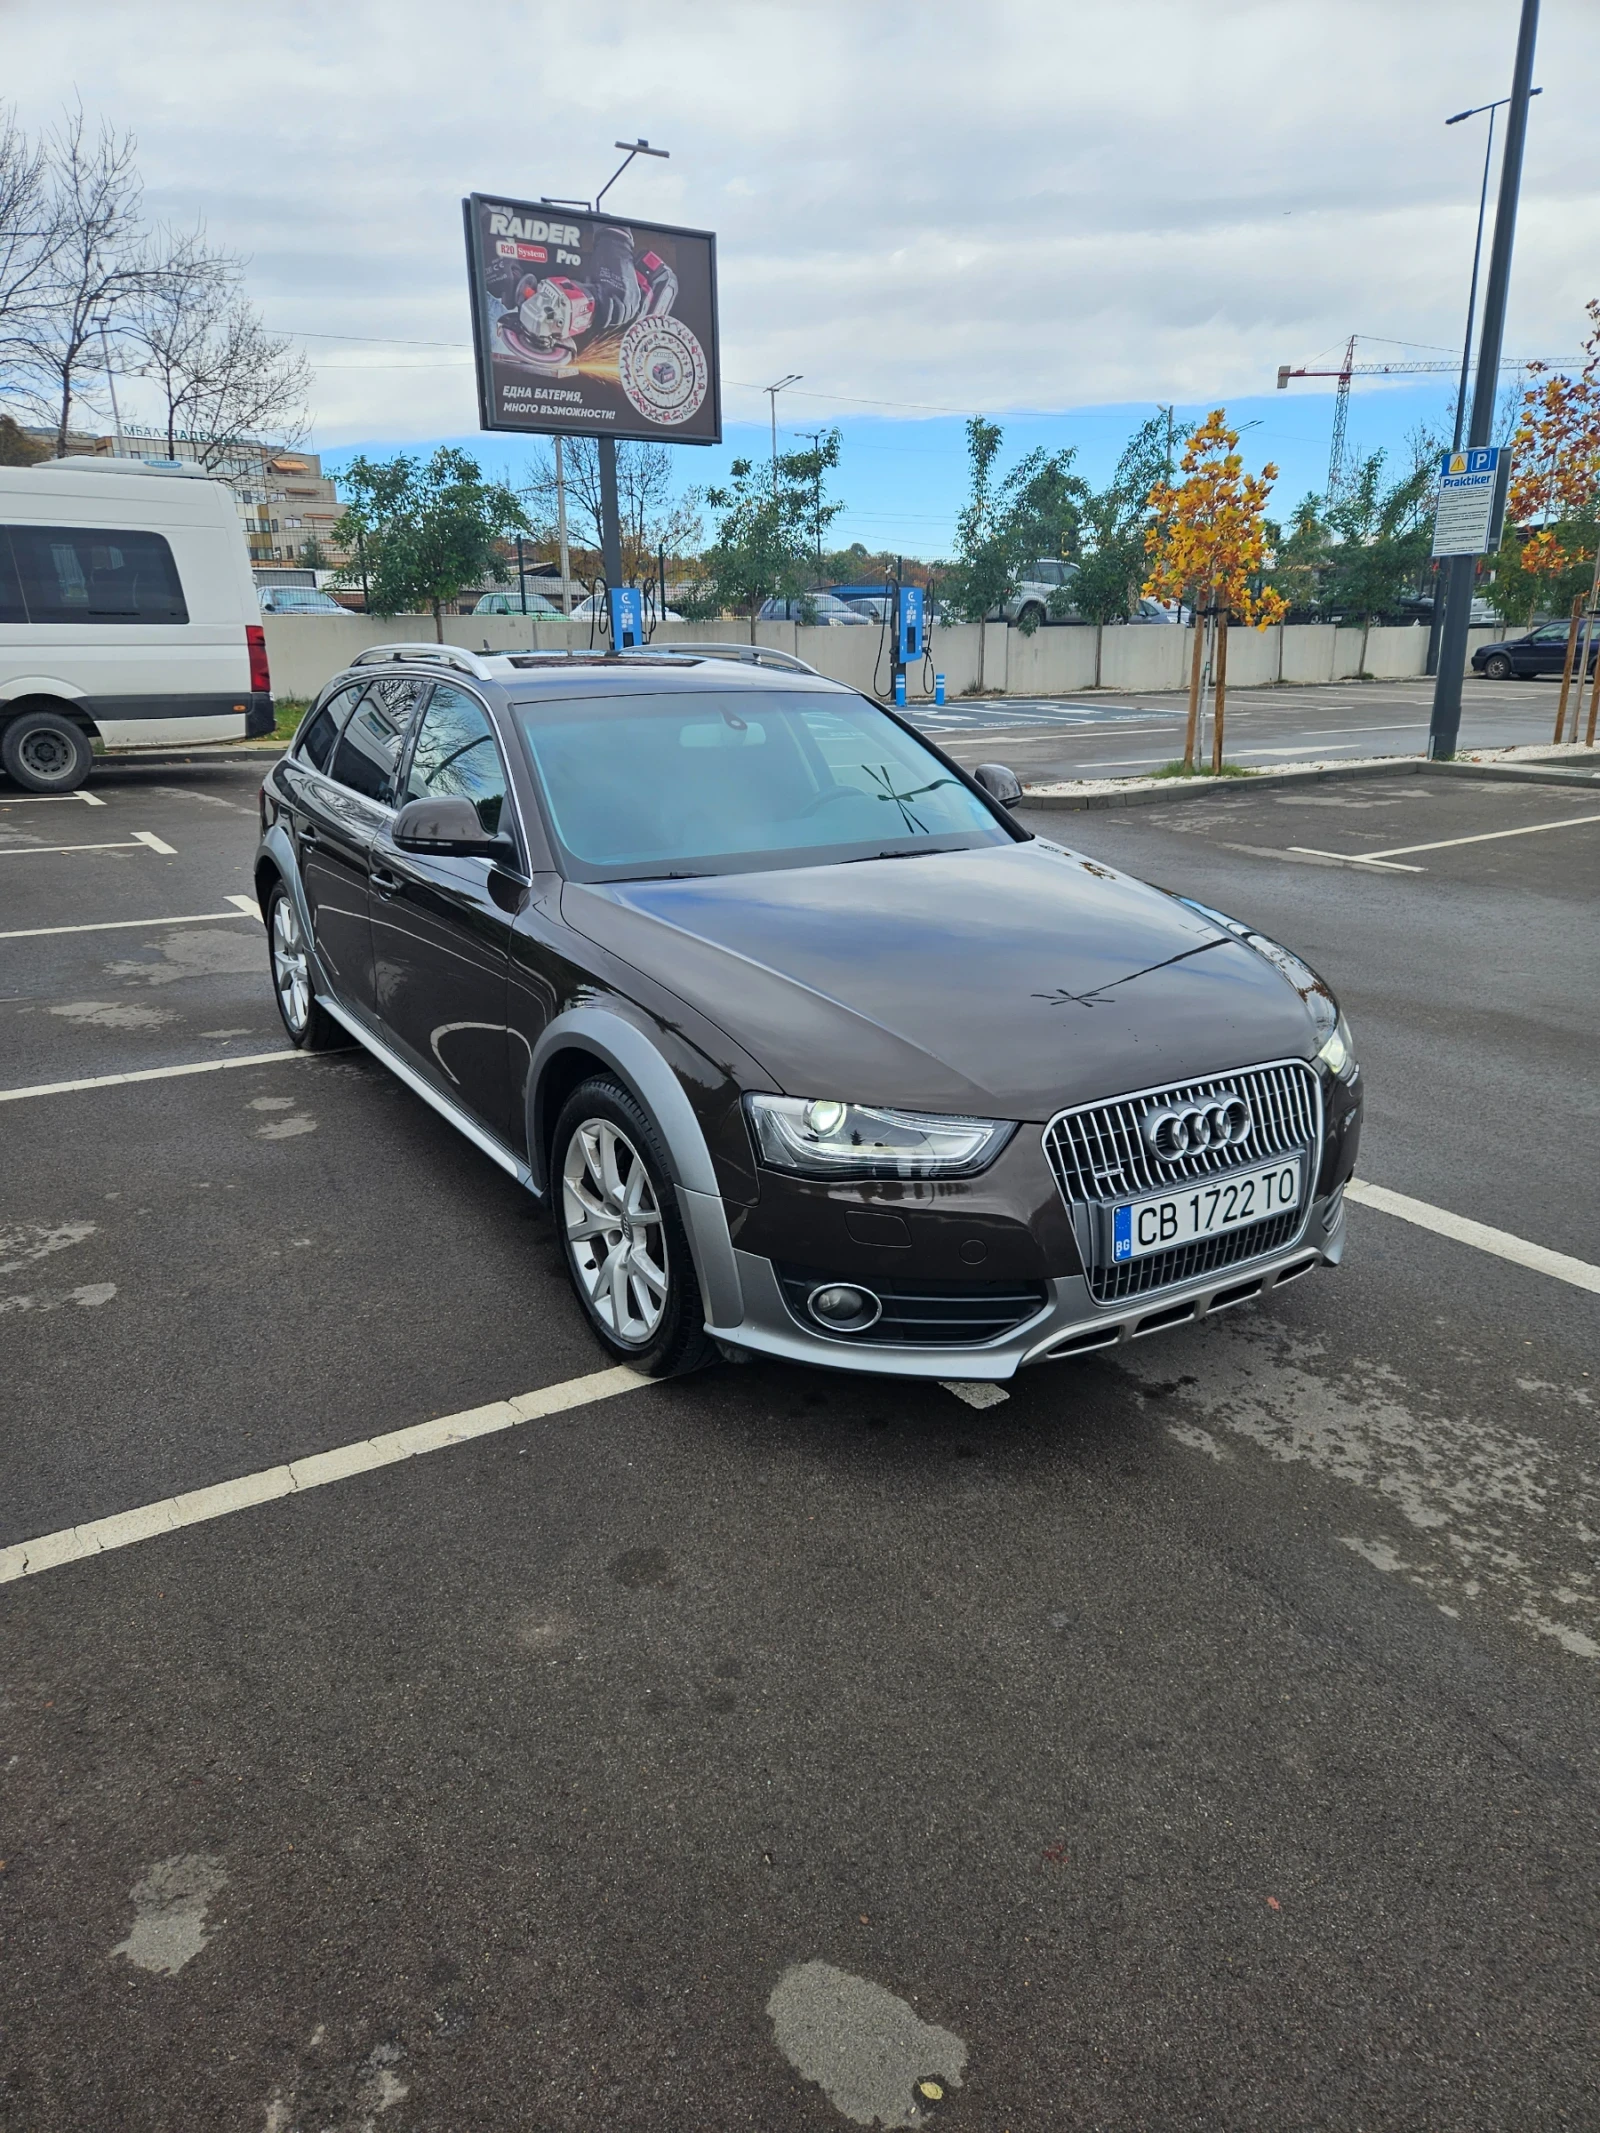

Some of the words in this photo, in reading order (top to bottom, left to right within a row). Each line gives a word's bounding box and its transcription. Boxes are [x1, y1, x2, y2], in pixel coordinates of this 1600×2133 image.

[489, 213, 581, 247] RAIDER
[500, 243, 515, 255] R20
[518, 247, 546, 259] System
[556, 249, 581, 266] Pro
[502, 385, 532, 398] ЕДНА
[534, 388, 583, 404] БАТЕРИЯ,
[503, 402, 539, 414] МНОГО
[540, 405, 616, 420] ВЪЗМОЖНОСТИ!
[123, 426, 161, 438] МБАЛ
[1476, 453, 1488, 469] P
[1443, 474, 1491, 489] Praktiker
[1138, 1202, 1178, 1245] CB
[1190, 1180, 1255, 1232] 1722
[1262, 1168, 1294, 1210] TO
[1115, 1239, 1131, 1253] BG
